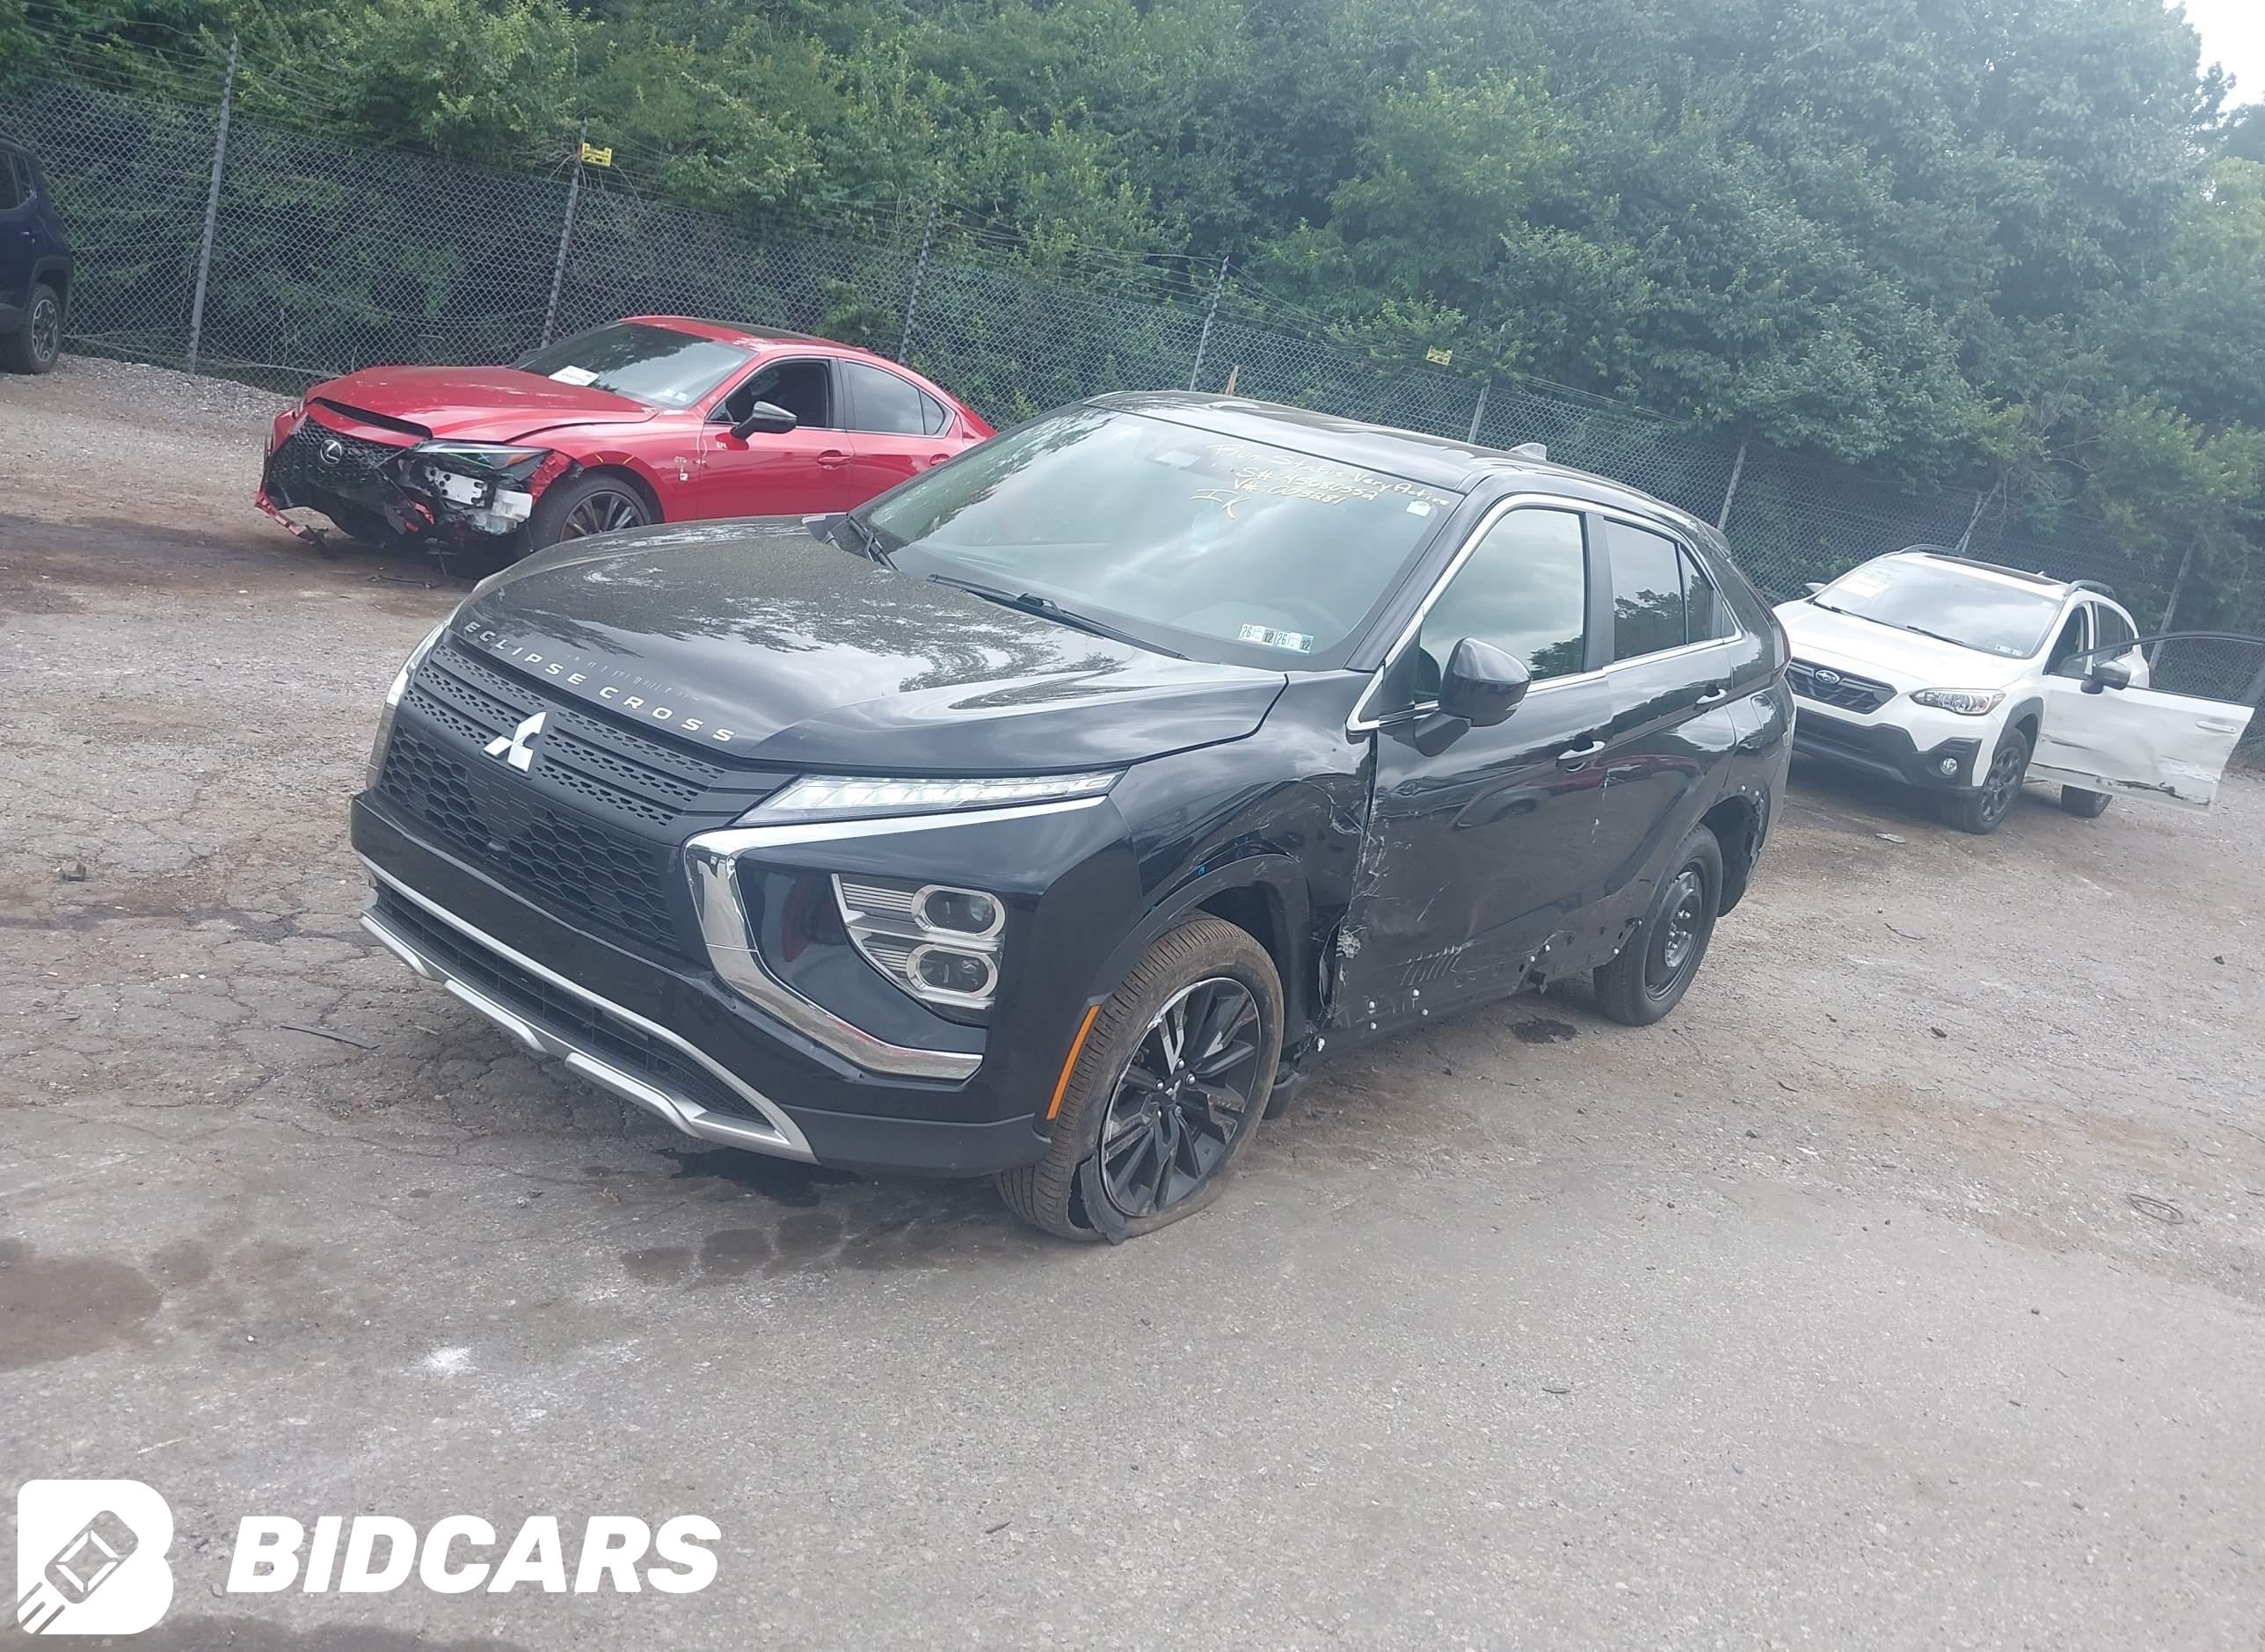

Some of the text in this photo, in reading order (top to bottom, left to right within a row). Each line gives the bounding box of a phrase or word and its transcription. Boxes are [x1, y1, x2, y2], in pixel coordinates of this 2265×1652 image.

[1264, 632, 1275, 644] 12
[1277, 632, 1288, 645] 26
[1300, 639, 1311, 651] 12
[464, 621, 736, 742] ECLIPSE CROSS
